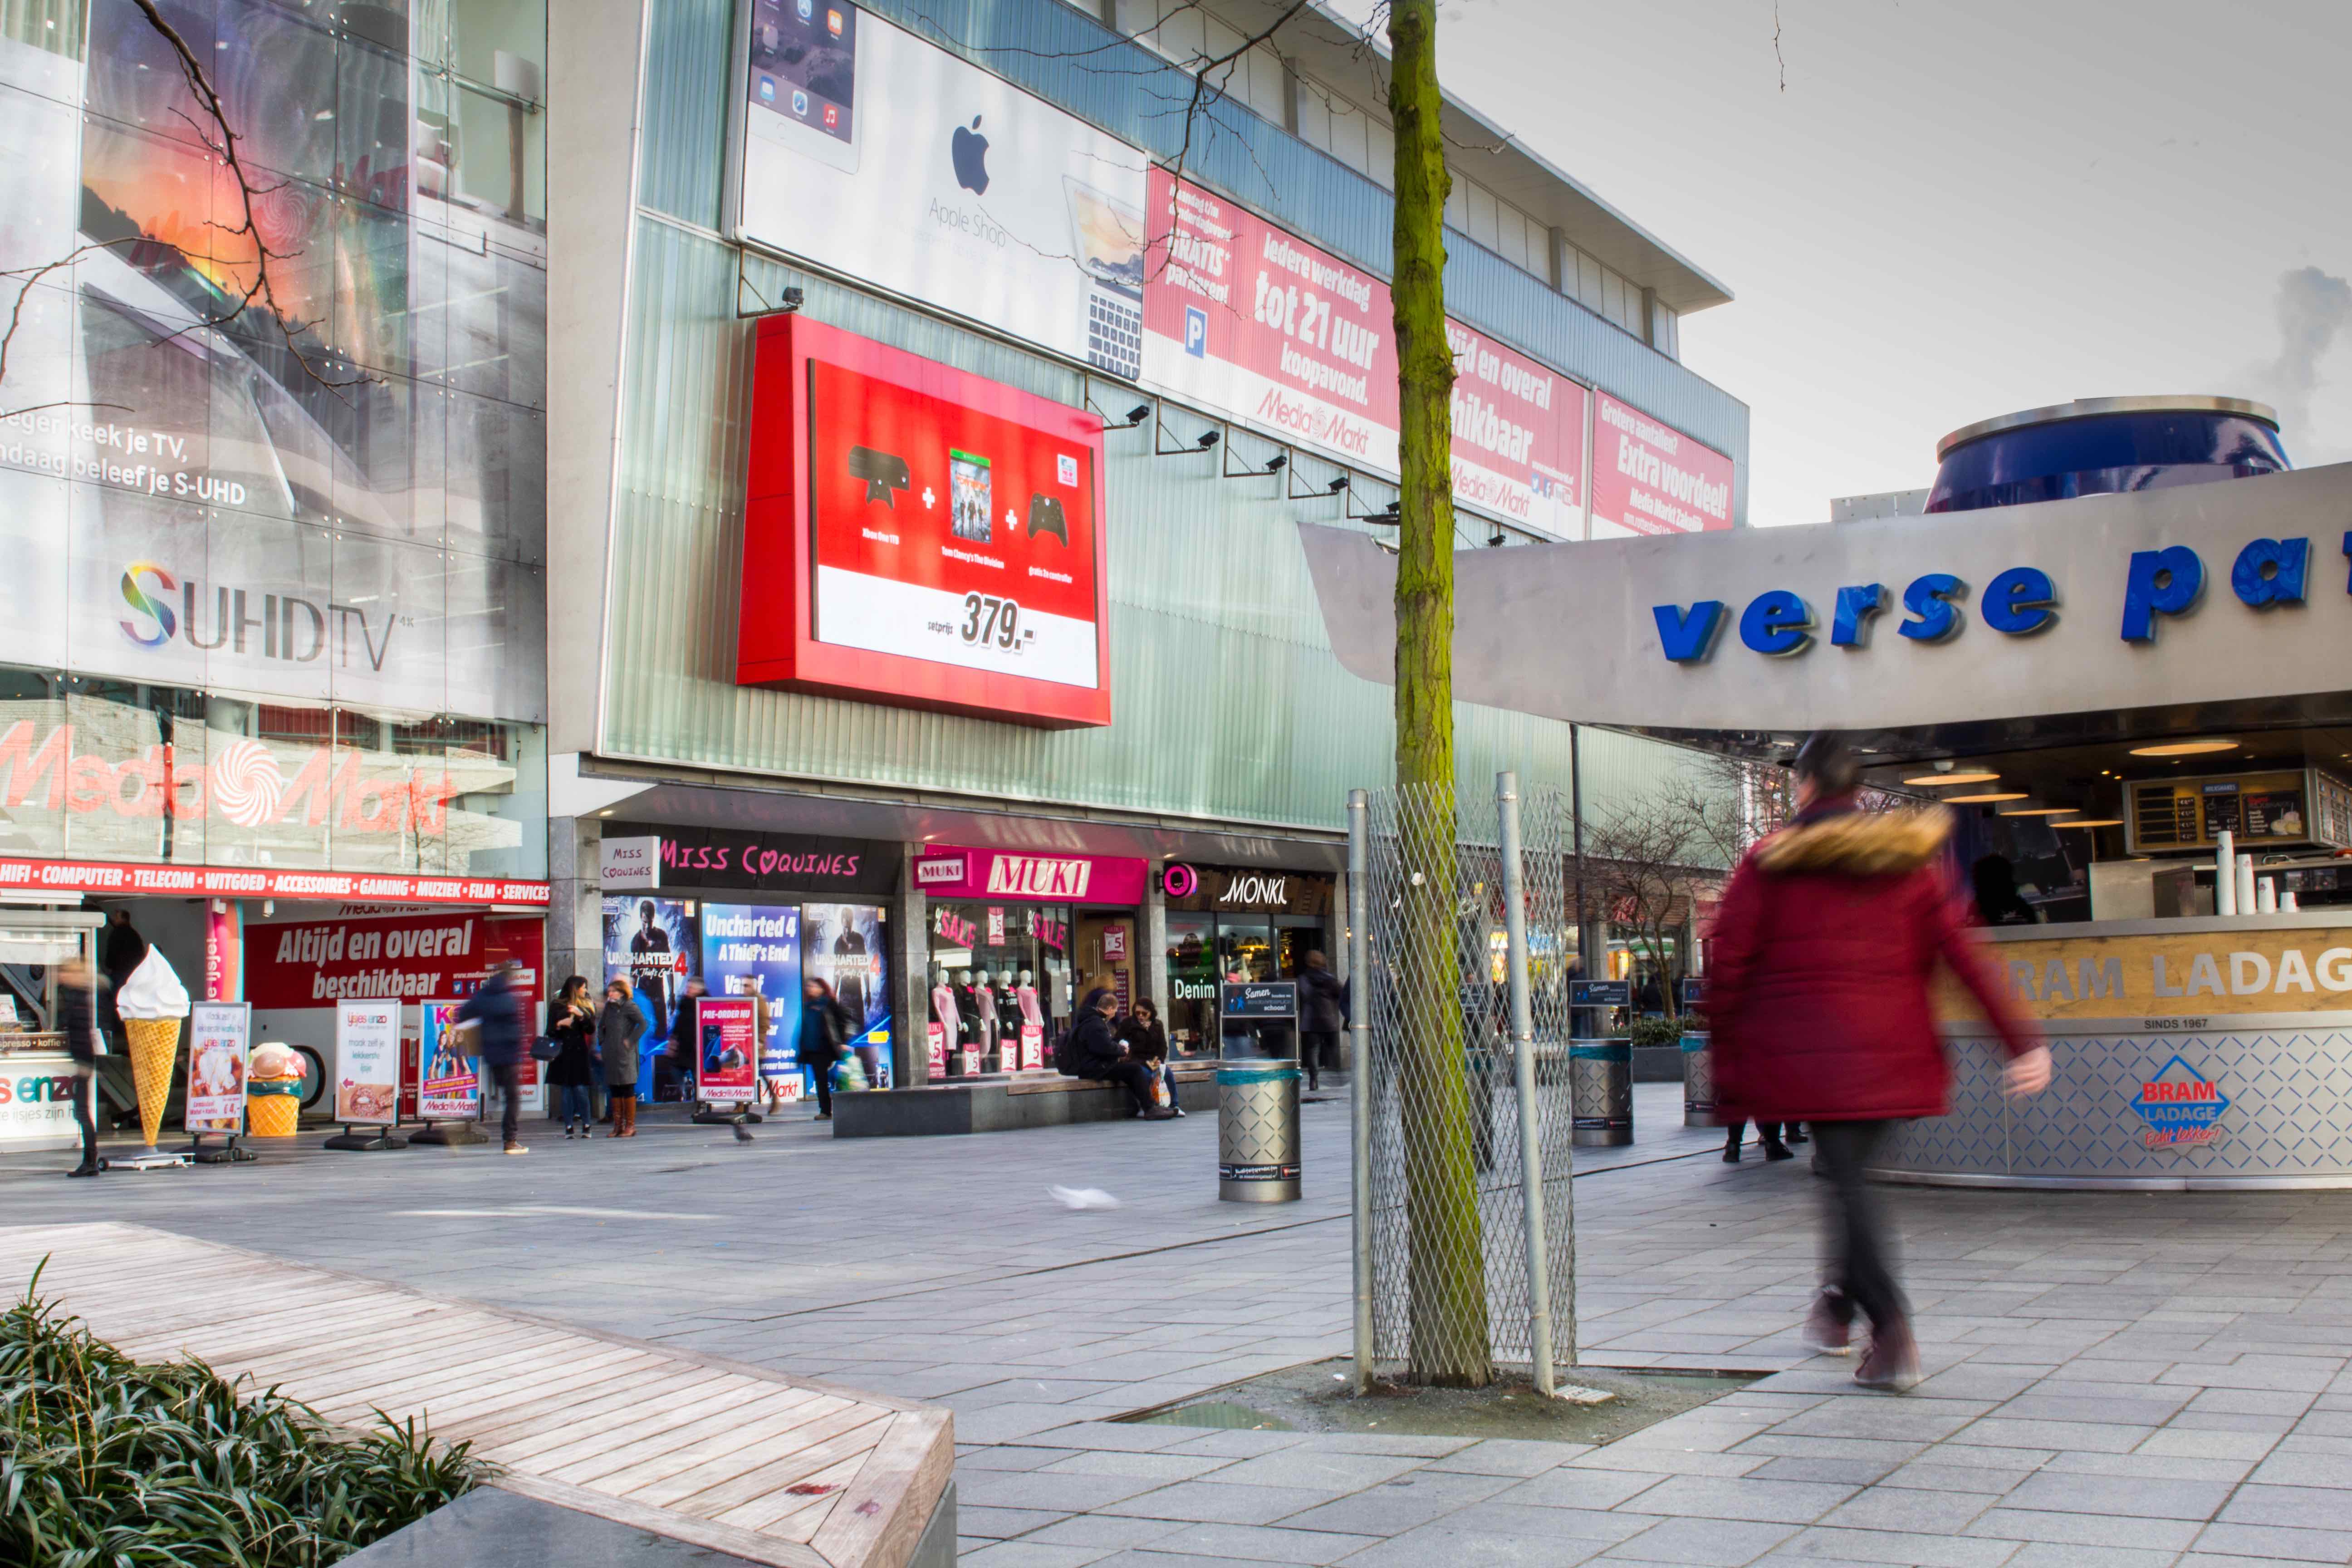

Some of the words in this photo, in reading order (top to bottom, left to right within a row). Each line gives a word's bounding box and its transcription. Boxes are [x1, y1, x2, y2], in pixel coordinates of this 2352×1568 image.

[929, 197, 969, 232] Apple
[973, 214, 1006, 251] Shop
[1168, 202, 1232, 242] dnderdagavond
[1166, 263, 1229, 304] parkeren!
[1264, 232, 1309, 278] Iedere
[1311, 259, 1371, 313] werkdag
[1255, 270, 1297, 336] tot
[1299, 292, 1331, 351] 21
[1332, 315, 1380, 371] uur
[1280, 342, 1368, 405] koopavond.
[1445, 323, 1478, 377] tijd
[1477, 349, 1500, 385] en
[1500, 362, 1553, 411] overal
[1257, 387, 1313, 433] Media
[1323, 416, 1369, 455] Markt
[1450, 387, 1534, 466] hikbaar
[1601, 399, 1635, 436] Grotere
[1635, 419, 1678, 456] aantallen?
[70, 414, 122, 448] keek
[126, 427, 148, 455] je
[152, 432, 188, 463] TV,
[73, 453, 147, 487] beleef
[148, 467, 169, 496] je
[174, 472, 246, 505] S-UHD
[1450, 461, 1486, 501] Media
[1494, 482, 1531, 518] Markt
[1617, 433, 1661, 489] Extra
[1661, 461, 1728, 521] voordeel!
[1629, 486, 1654, 515] Media
[1653, 498, 1677, 525] Markt
[862, 528, 877, 539] Xbox
[878, 532, 889, 543] One
[941, 546, 952, 557] Tom
[953, 549, 973, 564] Clancy's
[973, 554, 984, 565] The
[983, 556, 1004, 569] Division
[1028, 566, 1043, 578] gratis
[1049, 571, 1073, 584] controller
[927, 620, 953, 635] setprijs
[1651, 566, 2060, 662] verse
[274, 746, 457, 836] Markt
[0, 864, 30, 883] HIFI
[42, 865, 123, 887] COMPUTER
[133, 869, 195, 889] TELECOM
[205, 871, 266, 892] WITGOED
[274, 875, 351, 894] ACCESSOIRES
[359, 879, 408, 896] GAMING
[416, 882, 461, 898] MUZIEK
[469, 883, 495, 899] FILM
[502, 885, 550, 901] SERVICES
[922, 864, 960, 877] MUKI
[994, 857, 1086, 894] MUKI
[706, 914, 785, 938] Uncharted
[785, 916, 797, 938] 4
[941, 911, 977, 951] SALE
[1033, 914, 1066, 951] SALE
[275, 926, 347, 968] Altijd
[348, 935, 380, 960] en
[386, 919, 474, 958] overal
[718, 943, 728, 961] A
[728, 943, 767, 962] Thief's
[767, 944, 790, 962] End
[1114, 936, 1122, 949] 5
[607, 951, 673, 965] UNCHARTED
[674, 951, 688, 976] 4
[815, 955, 869, 966] UNCHARTED
[871, 954, 881, 976] 4
[313, 970, 441, 999] beschikbaar
[1175, 979, 1215, 999] Denim
[1245, 987, 1270, 999] Samen
[1589, 983, 1609, 993] Samen
[2007, 957, 2125, 1002] RAM
[702, 1009, 740, 1019] PRE-ORDER
[740, 1009, 751, 1019] NU
[2144, 1019, 2179, 1029] SINDS
[2182, 1018, 2208, 1029] 1967
[0, 1039, 31, 1049] presso
[38, 1038, 61, 1048] koffie
[1024, 1026, 1040, 1035] MUKI
[1033, 1043, 1039, 1060] 5
[704, 1089, 726, 1098] Media
[731, 1088, 752, 1097] Markt
[2142, 1081, 2216, 1102] BRAM
[13, 1108, 42, 1123] ijsjes
[45, 1106, 65, 1122] zijn
[424, 1101, 449, 1111] Media
[454, 1101, 476, 1111] Markt
[2144, 1106, 2217, 1122] LADAGE
[2145, 1126, 2173, 1146] Echt
[2176, 1125, 2220, 1142] lekker!
